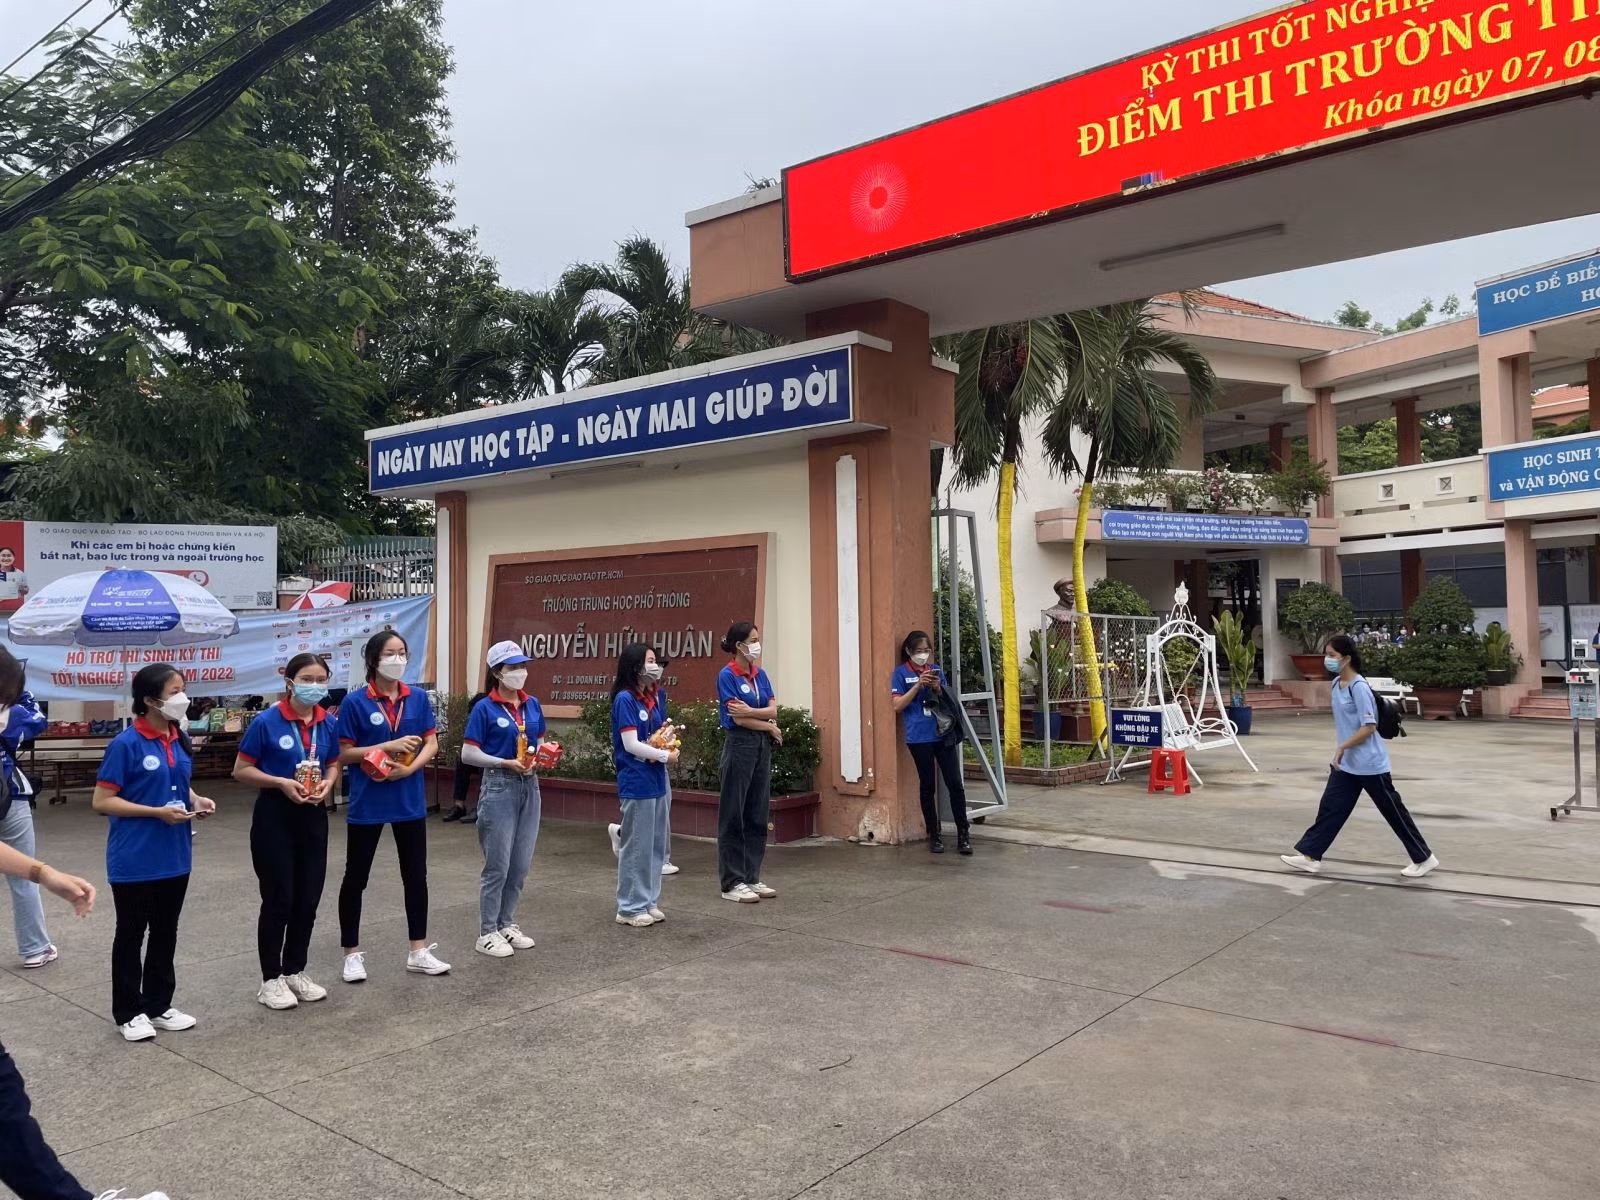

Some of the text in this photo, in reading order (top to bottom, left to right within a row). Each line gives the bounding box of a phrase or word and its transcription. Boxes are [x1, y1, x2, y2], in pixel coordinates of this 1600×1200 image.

[1141, 52, 1179, 89] KỲ
[1186, 36, 1241, 74] THI
[1248, 12, 1316, 55] TỐT
[1076, 96, 1182, 157] ĐIỂM
[1194, 70, 1274, 123] THI
[1285, 4, 1513, 96] TRƯỜNG
[1323, 91, 1404, 129] Khóa
[1412, 68, 1493, 108] ngày
[1501, 49, 1553, 83] 07,
[1493, 260, 1600, 305] HỌC ĐỂ BIẾ
[377, 441, 426, 477] NGÀY
[429, 437, 466, 469] NAY
[470, 430, 511, 467] HỌC
[516, 420, 554, 462] TẬP
[577, 404, 642, 447] NGÀY
[648, 396, 697, 435] MAI
[705, 378, 774, 425] GIÚP
[781, 364, 838, 412] ĐỜI
[1523, 453, 1553, 470] HỌC
[1556, 447, 1592, 464] SINH
[1499, 479, 1514, 492] và
[1516, 473, 1545, 491] VẬN
[1548, 469, 1590, 488] ĐỘNG
[71, 540, 90, 550] Khi
[92, 541, 113, 550] các
[116, 542, 135, 550] em
[130, 552, 160, 562] trong
[162, 553, 175, 561] và
[177, 554, 207, 563] ngoài
[580, 597, 610, 611] TRUNG
[521, 622, 599, 658] NGUYỄN
[652, 624, 713, 658] HUÂN
[143, 648, 175, 663] SINH
[200, 648, 221, 661] THI
[201, 668, 233, 682] 2022
[1115, 724, 1136, 732] KHÔNG
